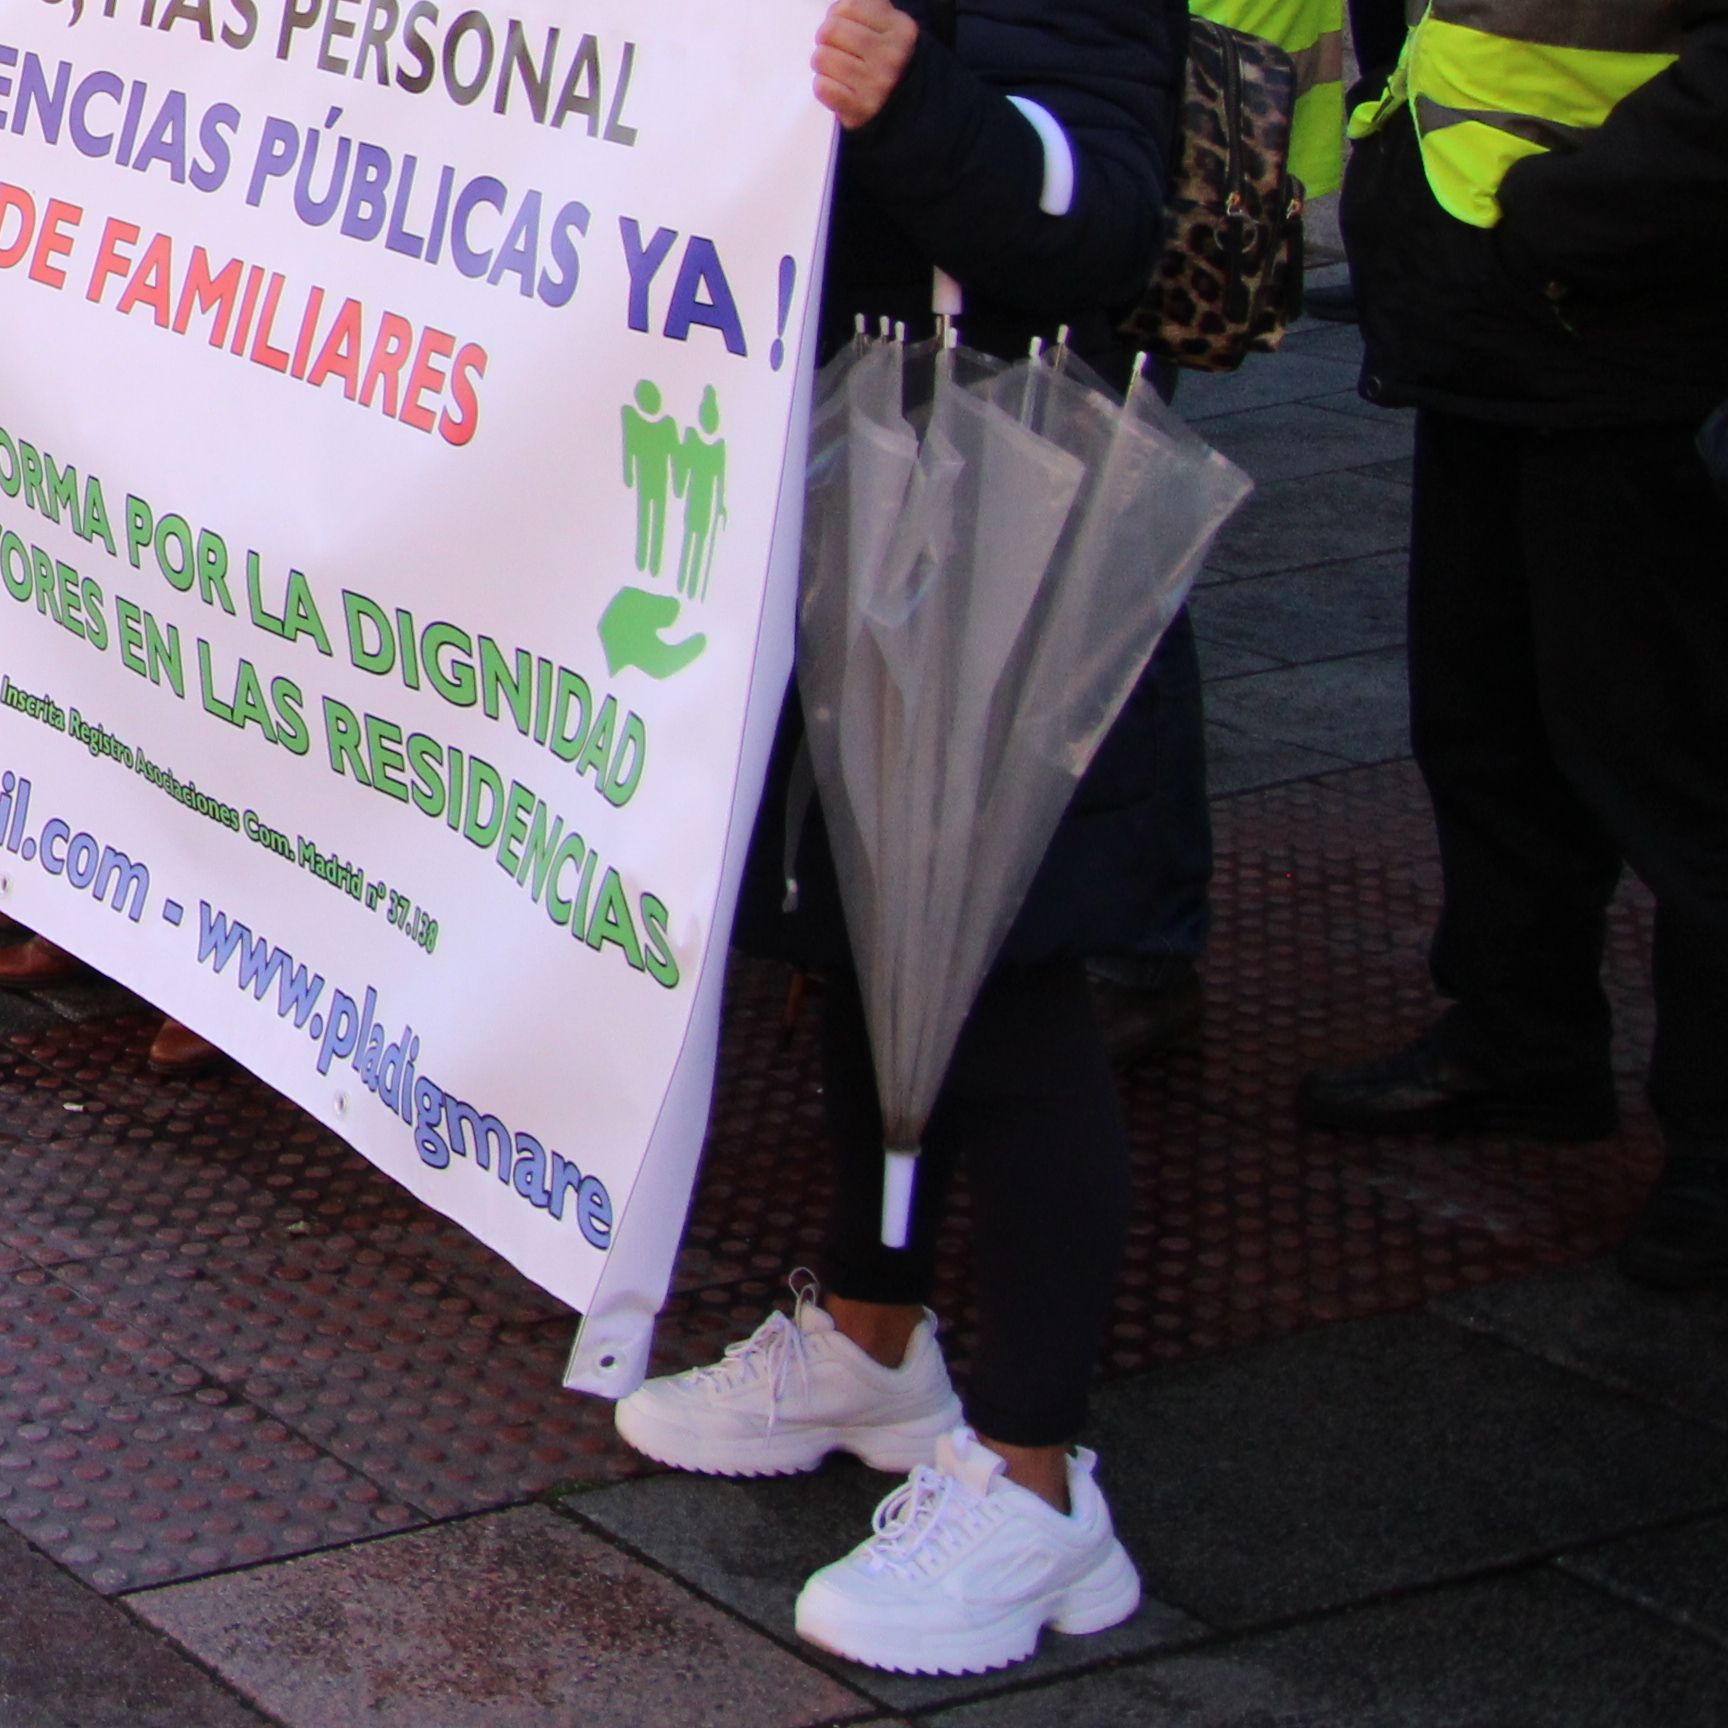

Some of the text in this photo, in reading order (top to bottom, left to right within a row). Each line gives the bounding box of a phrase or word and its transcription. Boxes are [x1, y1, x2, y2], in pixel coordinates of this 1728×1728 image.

[86, 215, 489, 447] FAMILIARES
[245, 105, 591, 308] PÚBLICAS
[617, 215, 748, 358] YA
[114, 595, 185, 699] EN
[196, 637, 310, 756] LAS
[321, 695, 681, 990] RESIDENCIAS
[126, 493, 236, 616] POR
[246, 549, 334, 657] LA
[341, 588, 646, 809] DIGNIDAD
[0, 675, 66, 731] Inscrita
[69, 707, 134, 772] Registro
[135, 747, 241, 832] Asociaciones
[243, 809, 296, 863] Com.
[297, 834, 364, 903] Madrid
[388, 888, 439, 955] 37.138
[197, 899, 613, 1250] www.pladigmare
